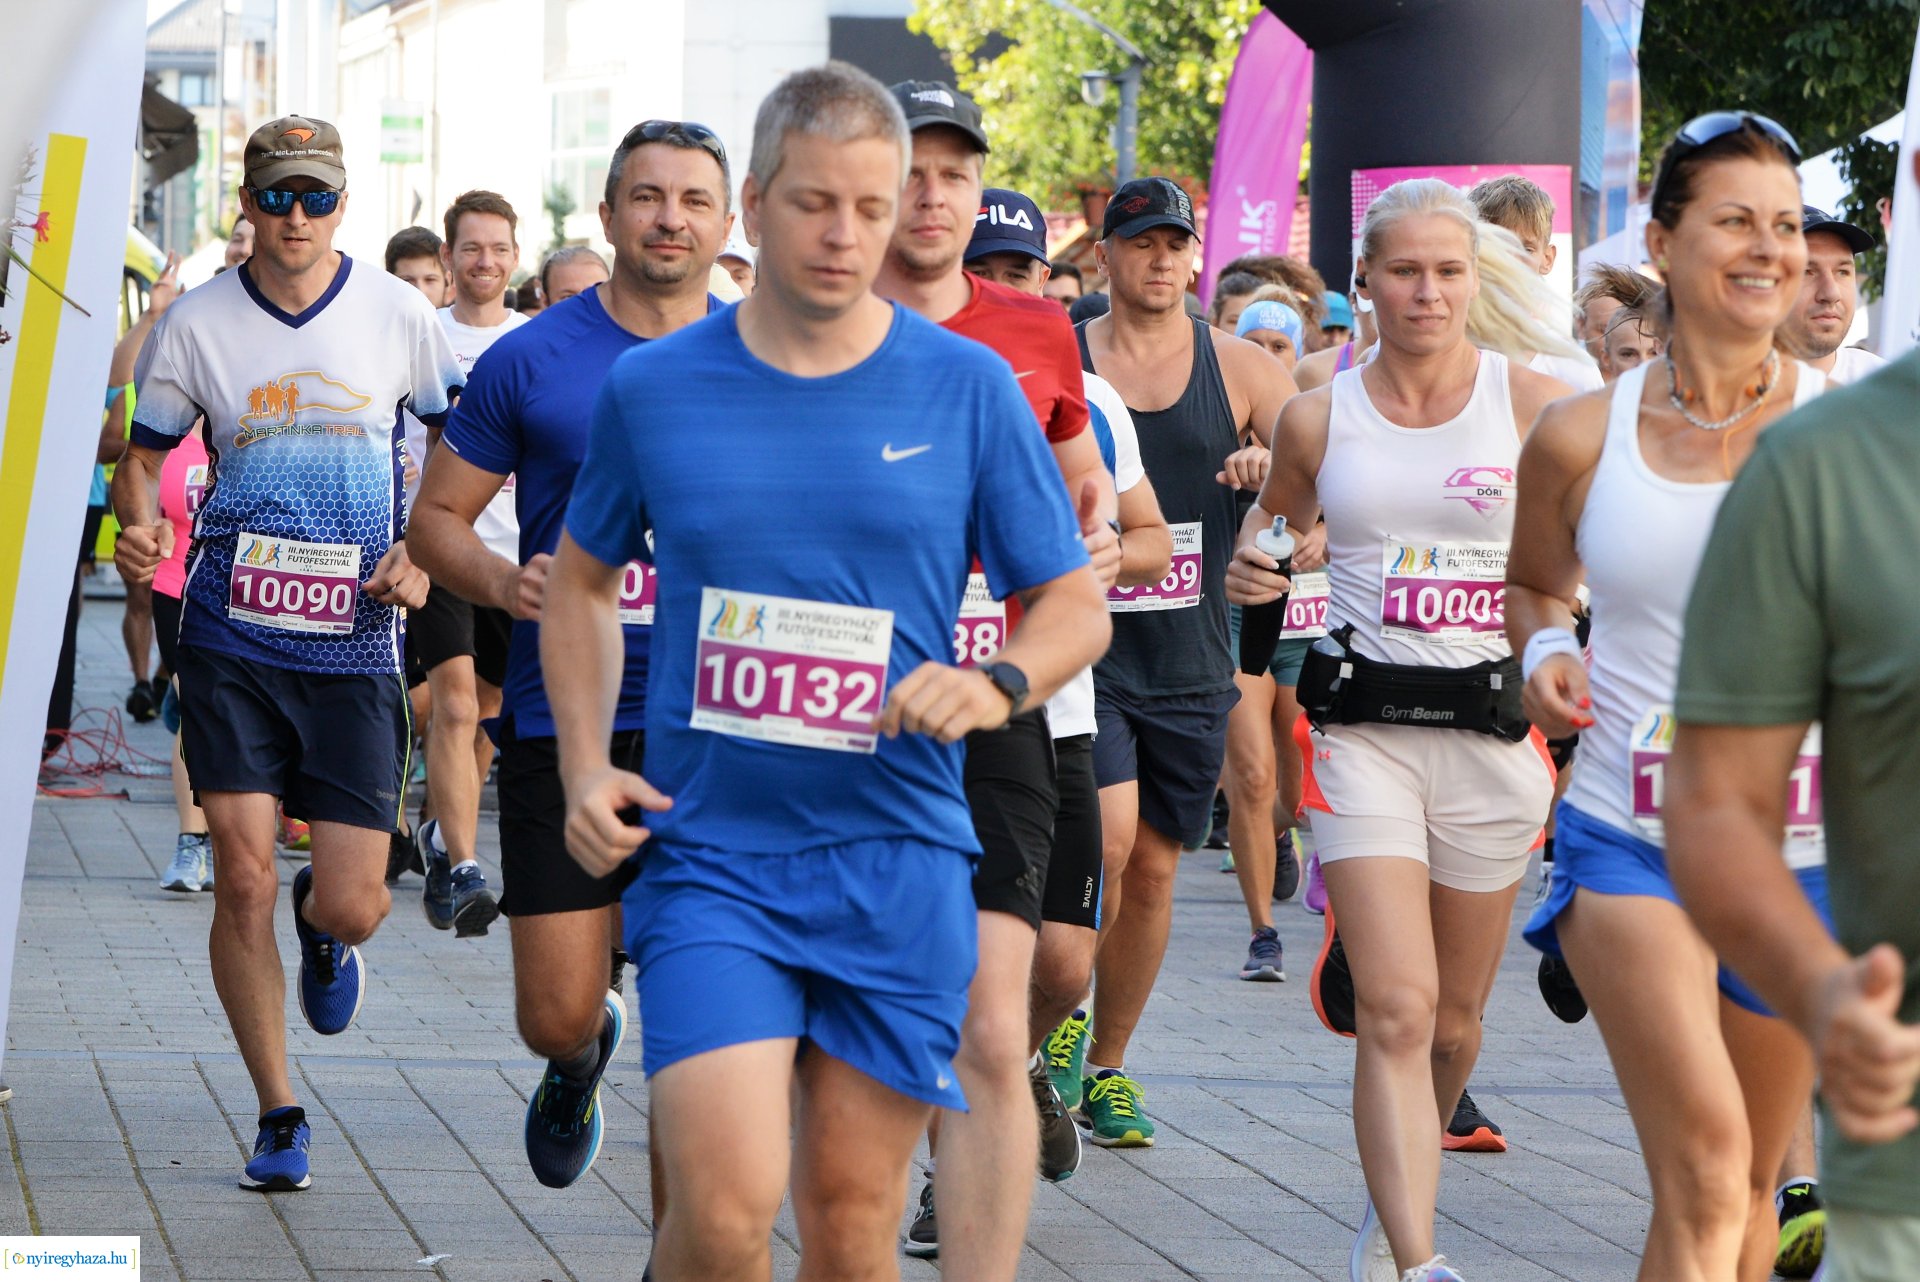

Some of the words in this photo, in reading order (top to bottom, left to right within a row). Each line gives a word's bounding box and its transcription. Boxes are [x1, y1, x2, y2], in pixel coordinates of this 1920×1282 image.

[287, 555, 352, 567] FUTÓFESZTIVÁL
[237, 574, 352, 615] 10090
[704, 652, 877, 724] 10132
[1381, 704, 1455, 722] GymBeam
[1082, 876, 1094, 909] ACTIVE
